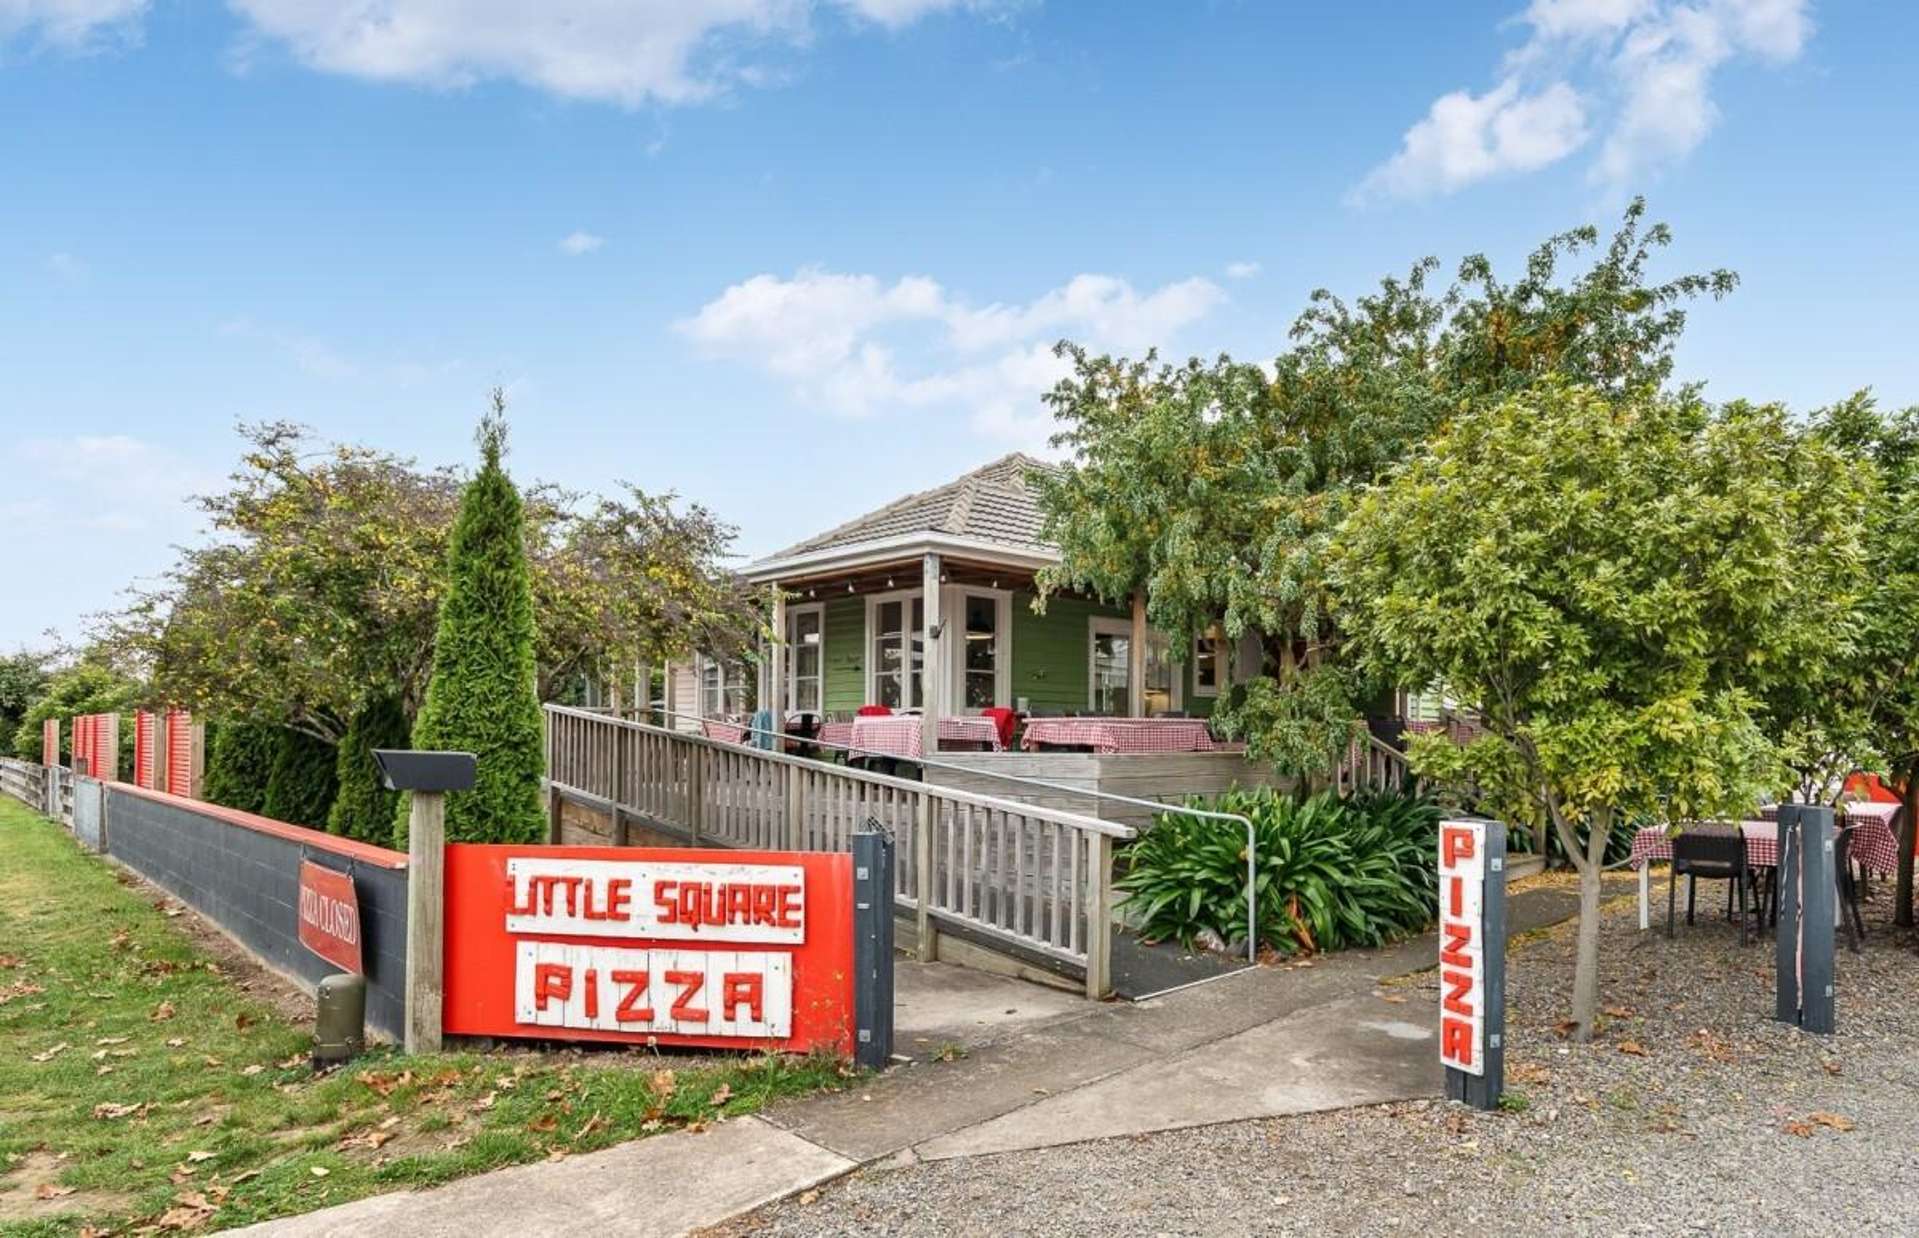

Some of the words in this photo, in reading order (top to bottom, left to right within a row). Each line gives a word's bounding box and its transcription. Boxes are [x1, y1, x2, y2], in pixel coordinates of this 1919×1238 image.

[319, 894, 356, 945] CLOSED
[505, 873, 632, 921] LITTLE
[653, 880, 801, 932] SQUARE
[1441, 827, 1474, 1066] PIZZA
[535, 963, 764, 1023] PIZZA
